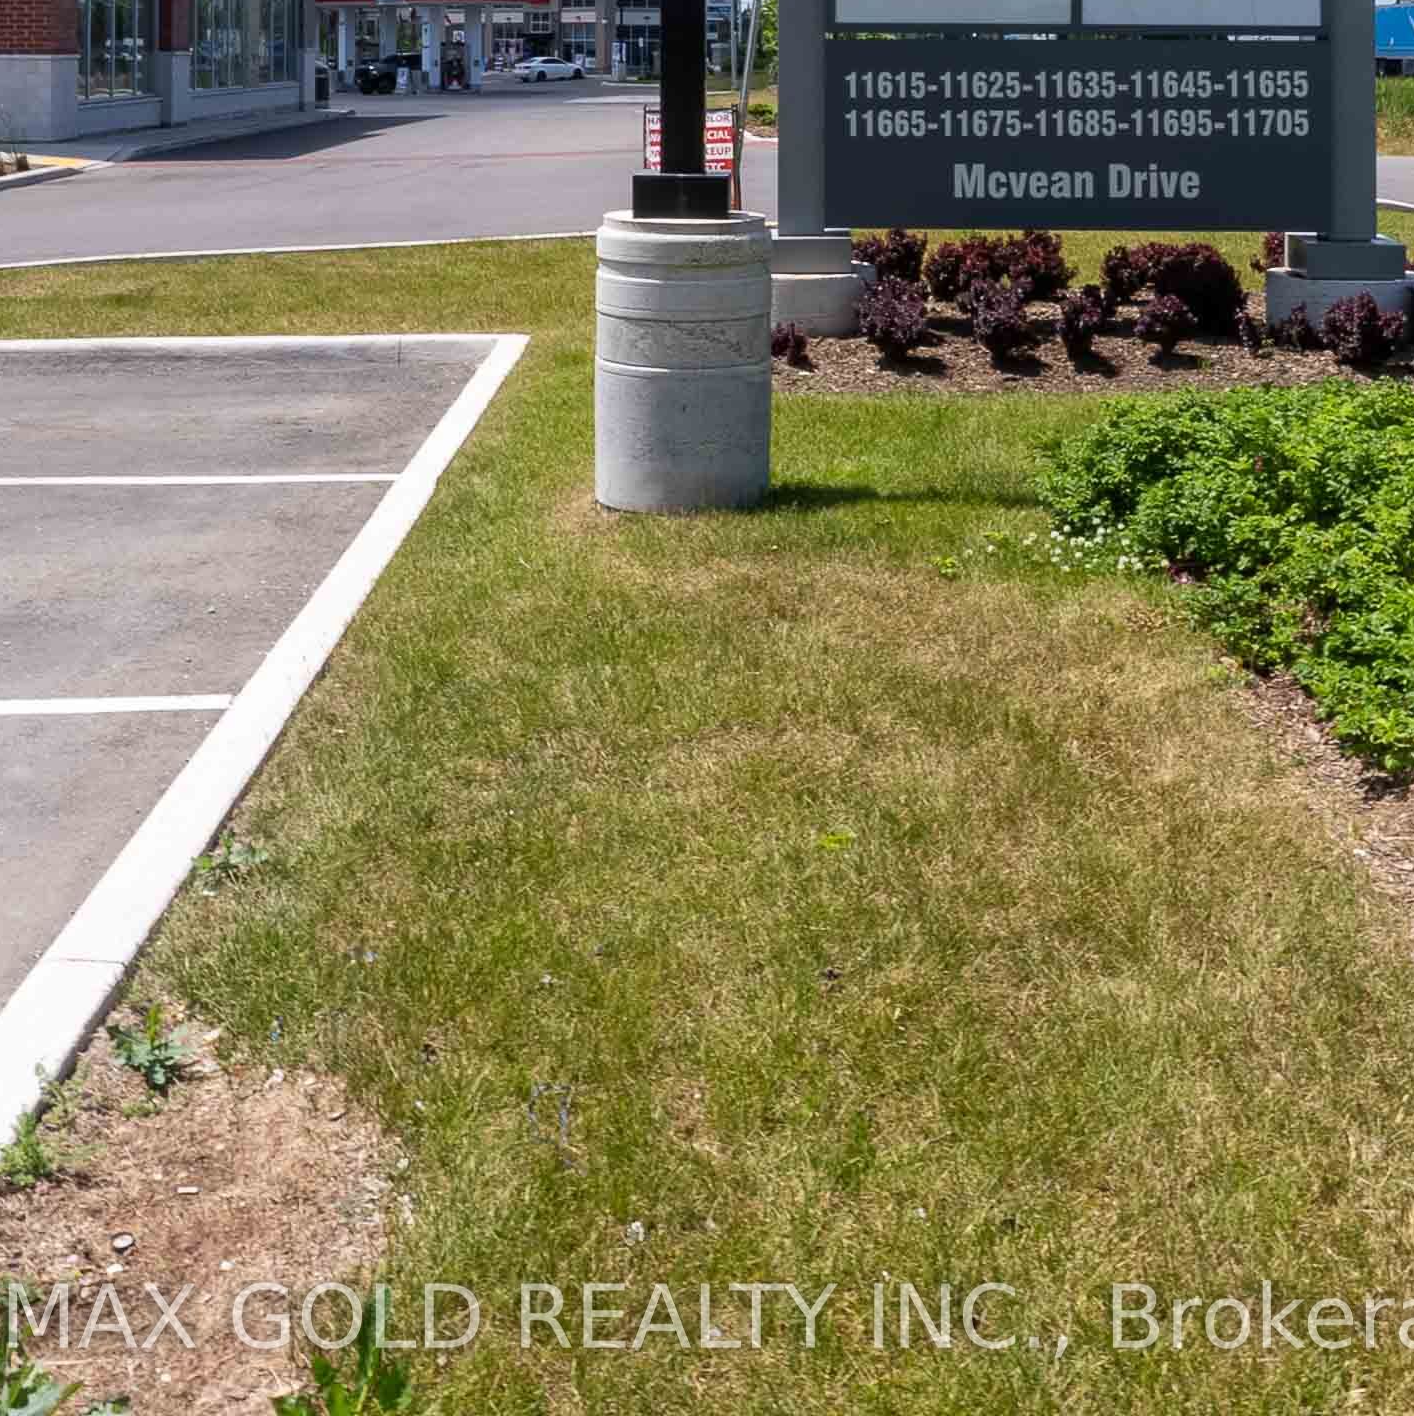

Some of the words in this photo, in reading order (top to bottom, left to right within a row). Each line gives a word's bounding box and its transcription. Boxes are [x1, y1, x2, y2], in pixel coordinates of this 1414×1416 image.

[844, 71, 1309, 99] 11615-11625-11635-11645-11655
[844, 109, 1309, 137] 11665-11675-11685-11695-11705
[953, 163, 1094, 199] Mcvean
[1108, 163, 1201, 199] Drive
